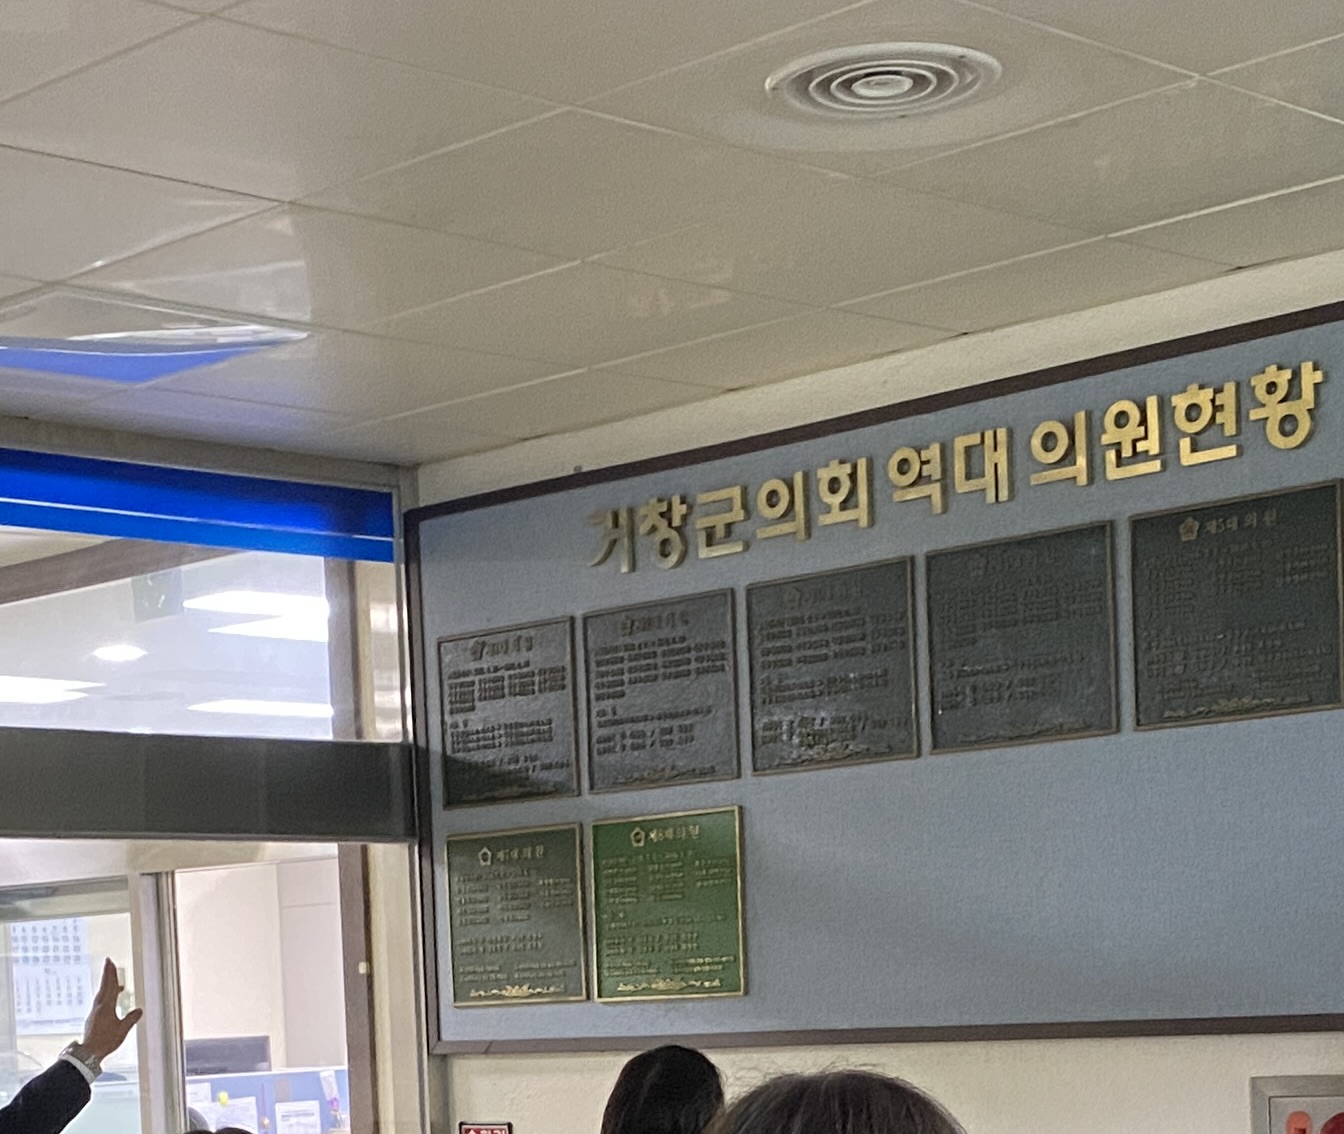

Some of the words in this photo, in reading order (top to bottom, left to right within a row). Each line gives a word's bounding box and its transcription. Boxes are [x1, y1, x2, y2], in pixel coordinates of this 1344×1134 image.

[587, 456, 874, 574] 거창군의회
[888, 427, 1016, 515] 역대
[1030, 361, 1323, 486] 의원현황
